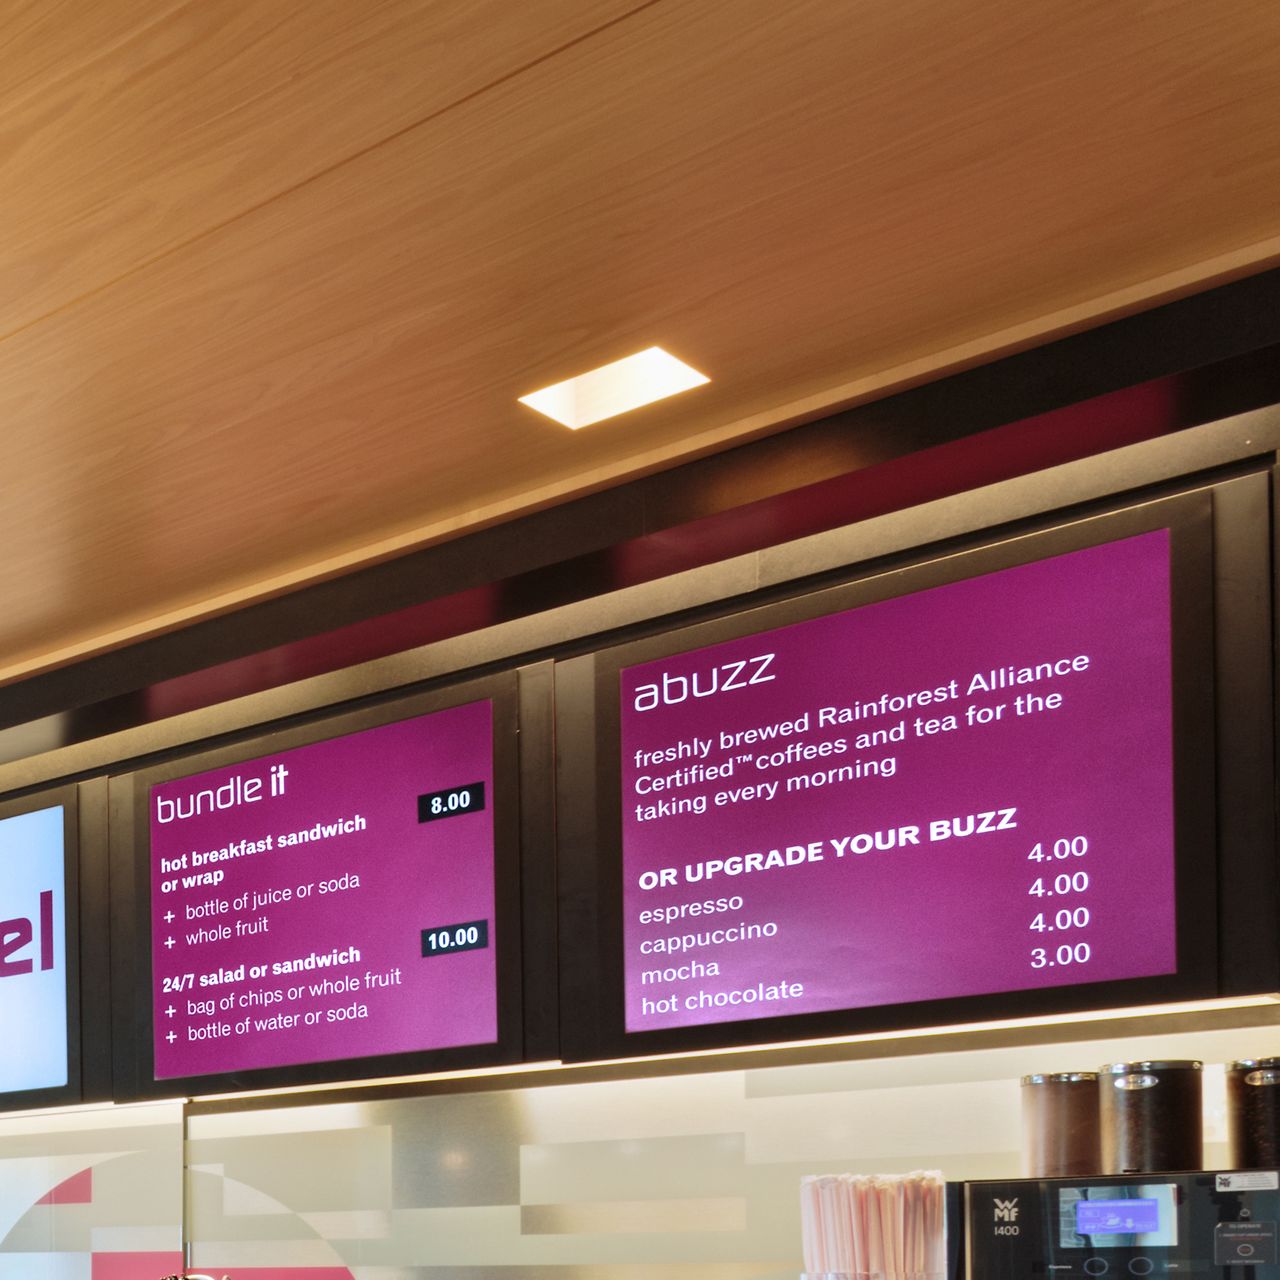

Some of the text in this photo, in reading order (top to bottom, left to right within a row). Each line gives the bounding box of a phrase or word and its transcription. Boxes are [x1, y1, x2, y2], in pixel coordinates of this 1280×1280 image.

[633, 655, 1090, 768] freshly brewed Rainforest Alliance
[634, 653, 776, 712] abuzz
[755, 738, 848, 770] coffees
[855, 720, 905, 749] and
[913, 715, 958, 737] tea
[965, 704, 1007, 726] for
[1013, 693, 1063, 716] the
[157, 764, 289, 824] bundle it
[634, 757, 896, 822] taking every morning
[161, 790, 471, 874] hot breakfast sandwich 8.00
[638, 807, 1017, 890] OR UPGRADE YOUR BUZZ
[161, 869, 224, 893] or wrap
[186, 898, 229, 920] bottle
[233, 892, 249, 911] of
[252, 888, 292, 911] juice
[296, 883, 314, 898] or
[318, 872, 360, 894] soda
[639, 836, 1088, 924] espresso 4.00
[640, 871, 1089, 954] cappuccino 4.00
[162, 926, 479, 993] 24/7 salad or sandwich 10.00
[185, 924, 232, 945] whole
[235, 916, 269, 937] fruit
[641, 907, 1090, 985] mocha 4.00
[187, 1000, 216, 1016] bag
[219, 992, 235, 1011] of
[238, 989, 283, 1007] chips
[287, 986, 305, 1000] or
[308, 975, 360, 997] whole
[364, 968, 402, 989] fruit
[642, 942, 1091, 1015] hot chocolate 3.00
[188, 1021, 231, 1041] bottle
[235, 1016, 251, 1035] of
[254, 1013, 301, 1031] water
[304, 1011, 323, 1025] or
[326, 1002, 369, 1022] soda
[993, 1197, 1019, 1221] WMF
[994, 1225, 1020, 1236] 1400
